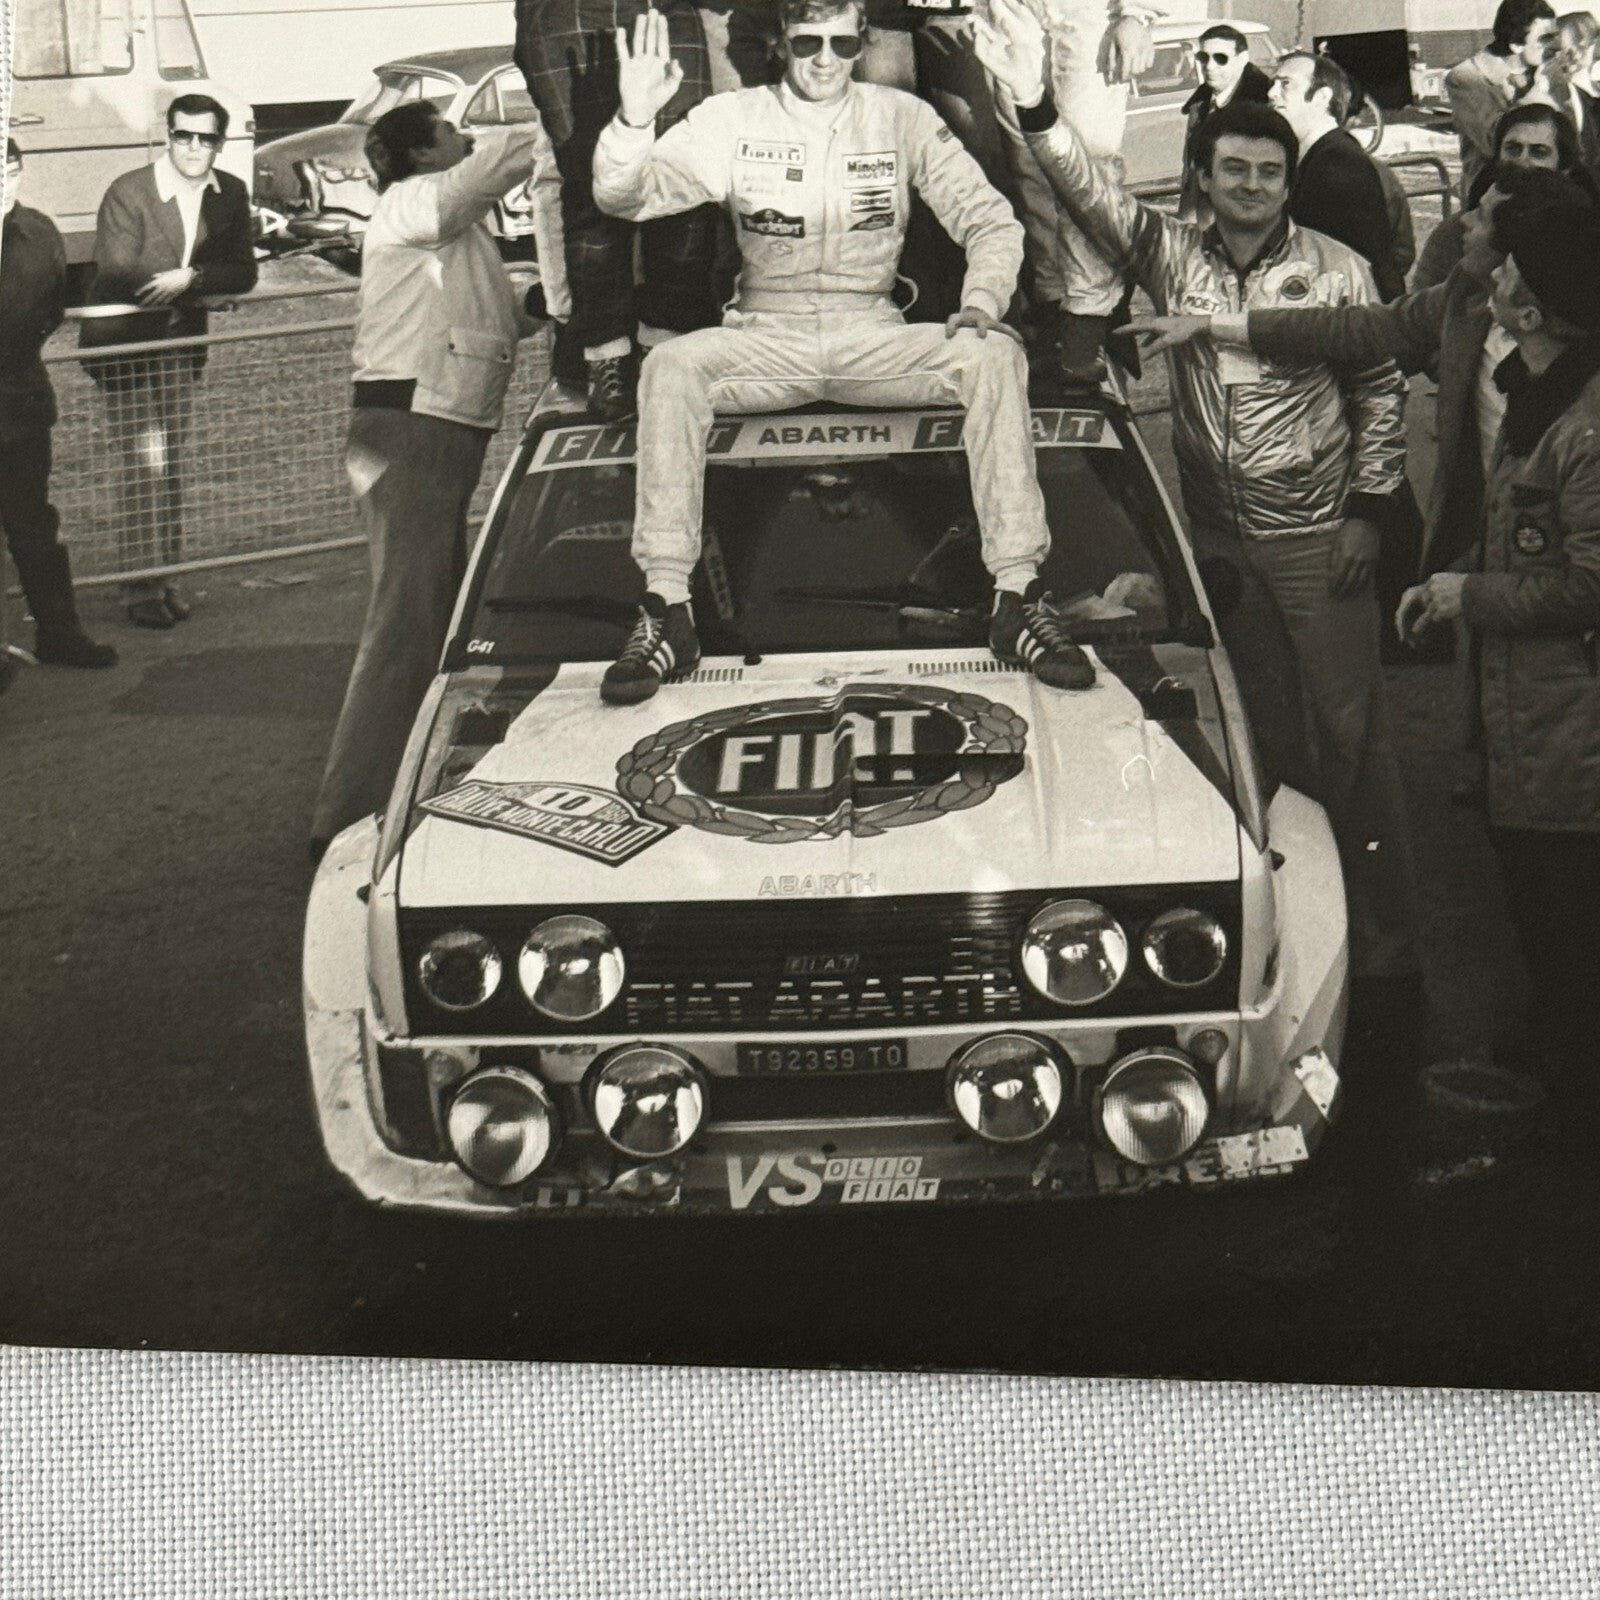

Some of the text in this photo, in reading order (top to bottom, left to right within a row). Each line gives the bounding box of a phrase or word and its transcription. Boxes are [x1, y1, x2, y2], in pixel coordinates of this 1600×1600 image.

[847, 159, 895, 172] Minolta
[559, 416, 1097, 458] FIT ABARTH FAT
[717, 709, 931, 793] FIAT
[541, 791, 592, 811] 10
[758, 871, 880, 896] ABARTH
[785, 954, 859, 973] FIAT
[626, 982, 753, 1024] FIAT
[749, 1045, 902, 1073] T92359 TO
[726, 1151, 827, 1210] VS
[828, 1159, 918, 1178] OLIO
[847, 1181, 935, 1200] FIAT
